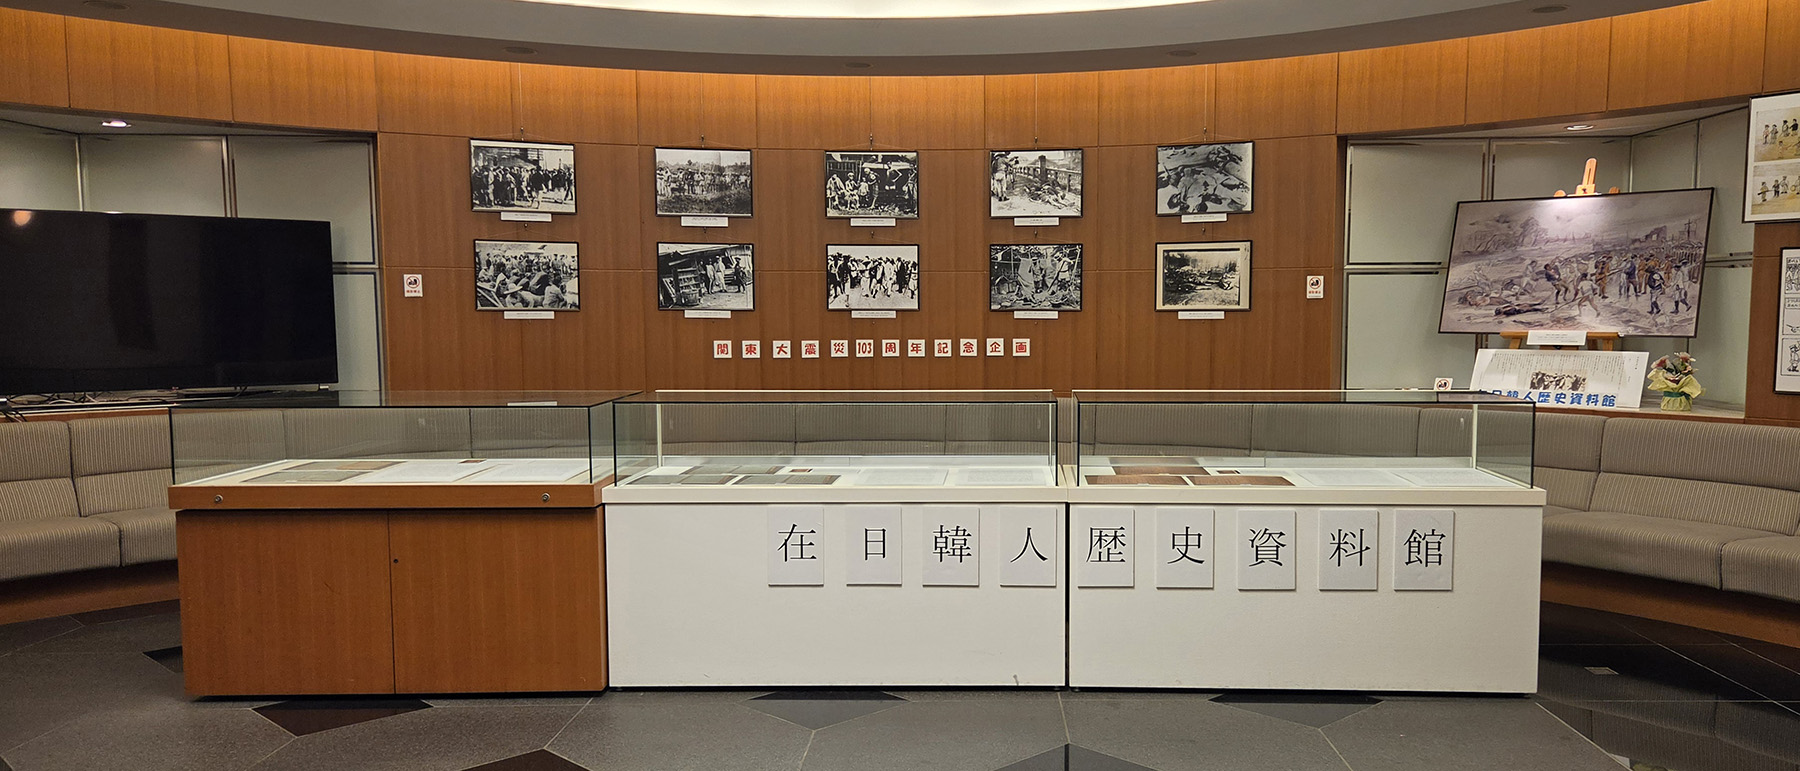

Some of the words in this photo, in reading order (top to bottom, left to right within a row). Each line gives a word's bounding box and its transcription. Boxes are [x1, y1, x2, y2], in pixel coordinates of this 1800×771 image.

[777, 523, 1446, 568] 在日韓人歴史資料館
